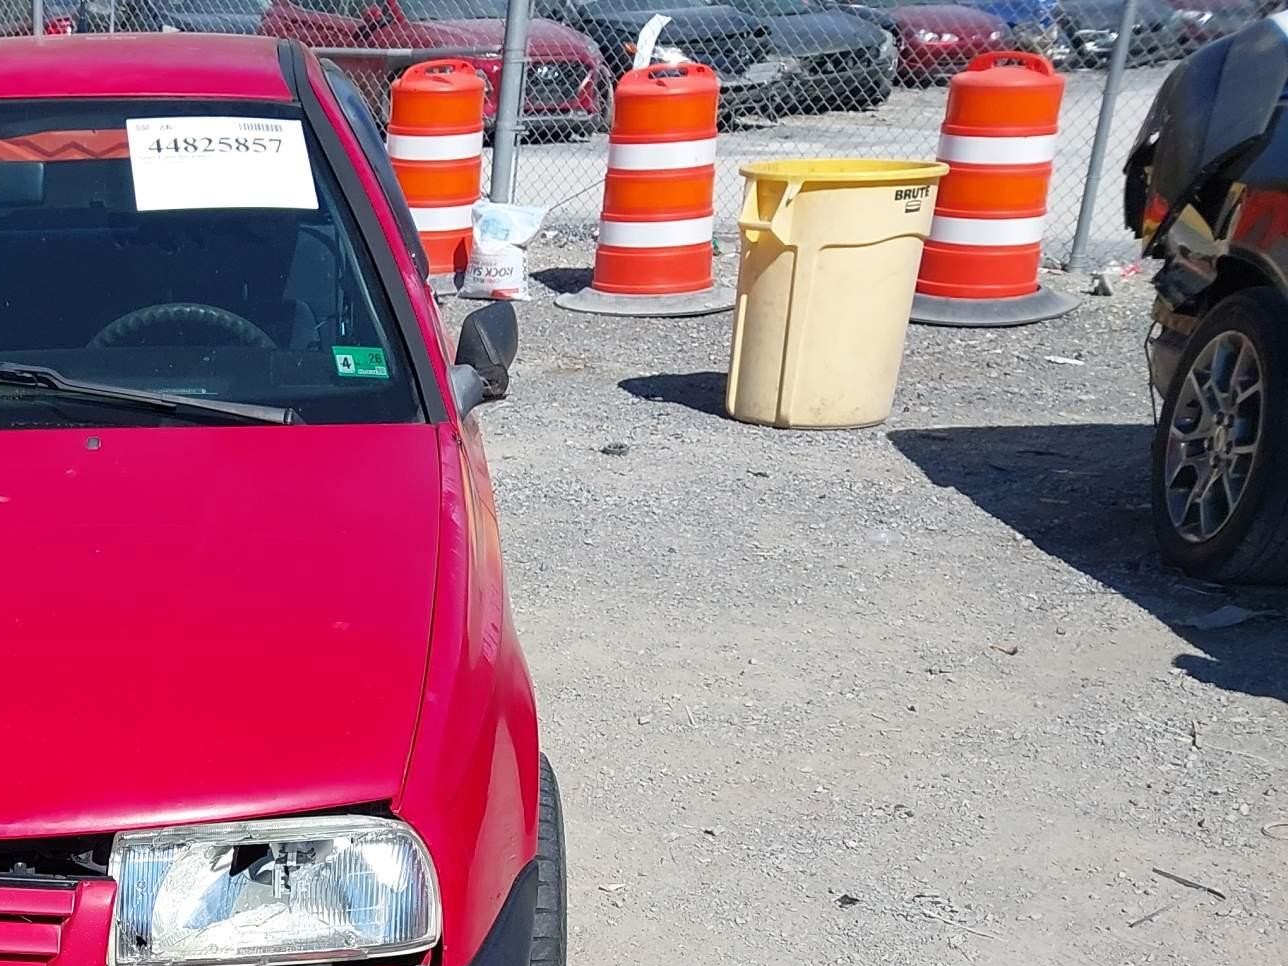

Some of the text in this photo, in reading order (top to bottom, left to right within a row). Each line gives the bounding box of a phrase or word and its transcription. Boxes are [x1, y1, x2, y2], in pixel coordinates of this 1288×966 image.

[148, 137, 283, 154] 44825857
[894, 185, 931, 201] BRUTE
[485, 266, 514, 278] ROCK
[341, 357, 352, 369] 4
